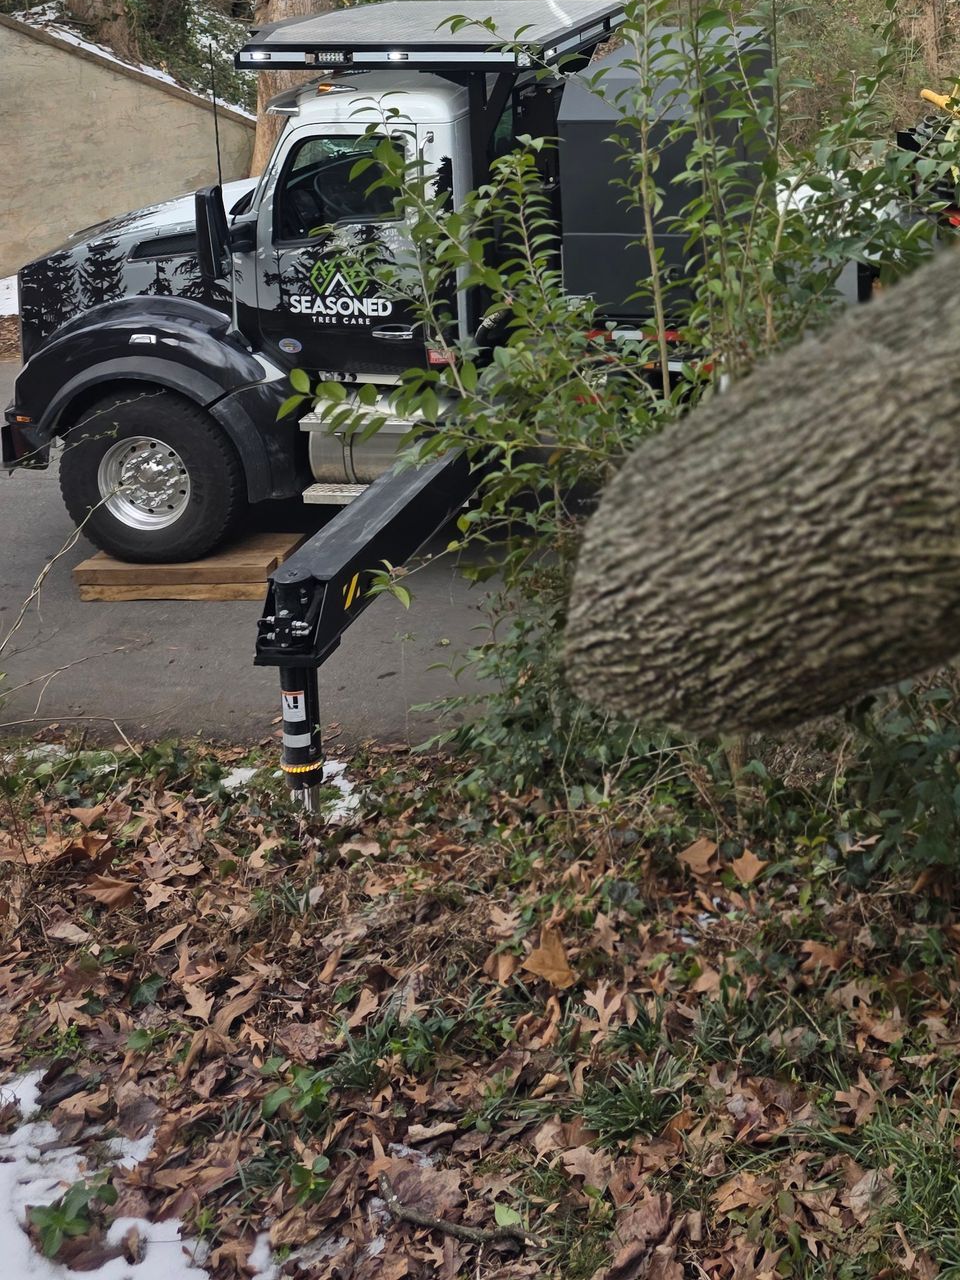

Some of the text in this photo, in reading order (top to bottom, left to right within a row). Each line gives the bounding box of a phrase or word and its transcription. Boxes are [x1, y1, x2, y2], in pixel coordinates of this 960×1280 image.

[290, 295, 392, 317] SEASONED
[312, 316, 371, 325] TREE CARE
